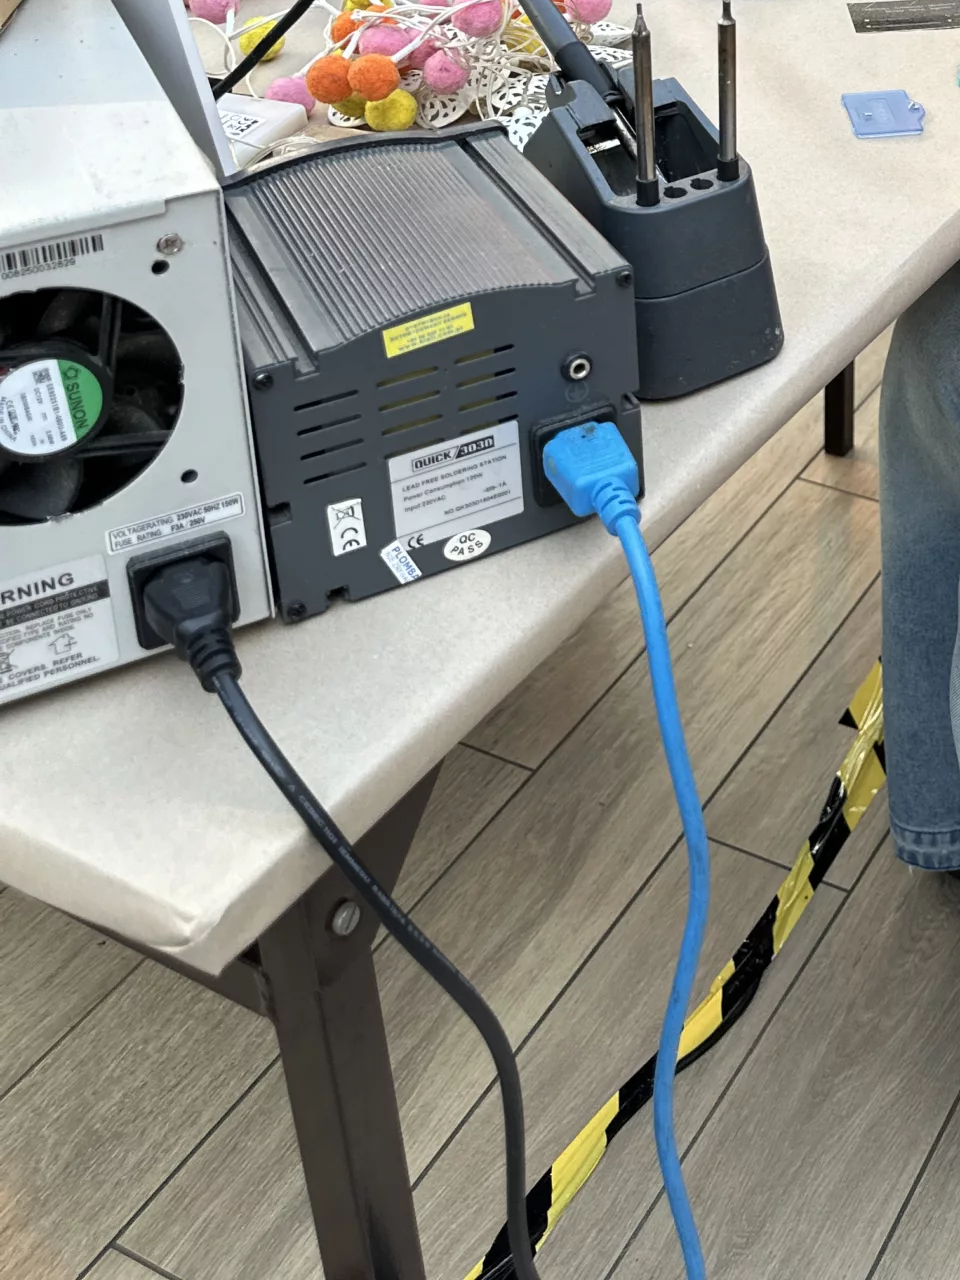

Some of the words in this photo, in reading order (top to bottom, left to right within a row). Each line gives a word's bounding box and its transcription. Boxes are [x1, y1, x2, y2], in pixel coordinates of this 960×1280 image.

[66, 382, 88, 429] SUNON
[414, 450, 452, 469] QUICK
[402, 482, 420, 492] LEAD
[421, 476, 438, 486] FREE
[440, 464, 478, 480] SOLDERING
[479, 455, 507, 467] STATION
[176, 507, 203, 521] 230VAC
[203, 502, 220, 513] 50HZ
[221, 497, 239, 508] 150W
[114, 538, 133, 549] FUSE
[408, 534, 424, 549] CE
[459, 532, 476, 544] QC
[450, 540, 484, 556] PASS
[391, 546, 419, 580] PLOMBA
[52, 652, 83, 666] REFER
